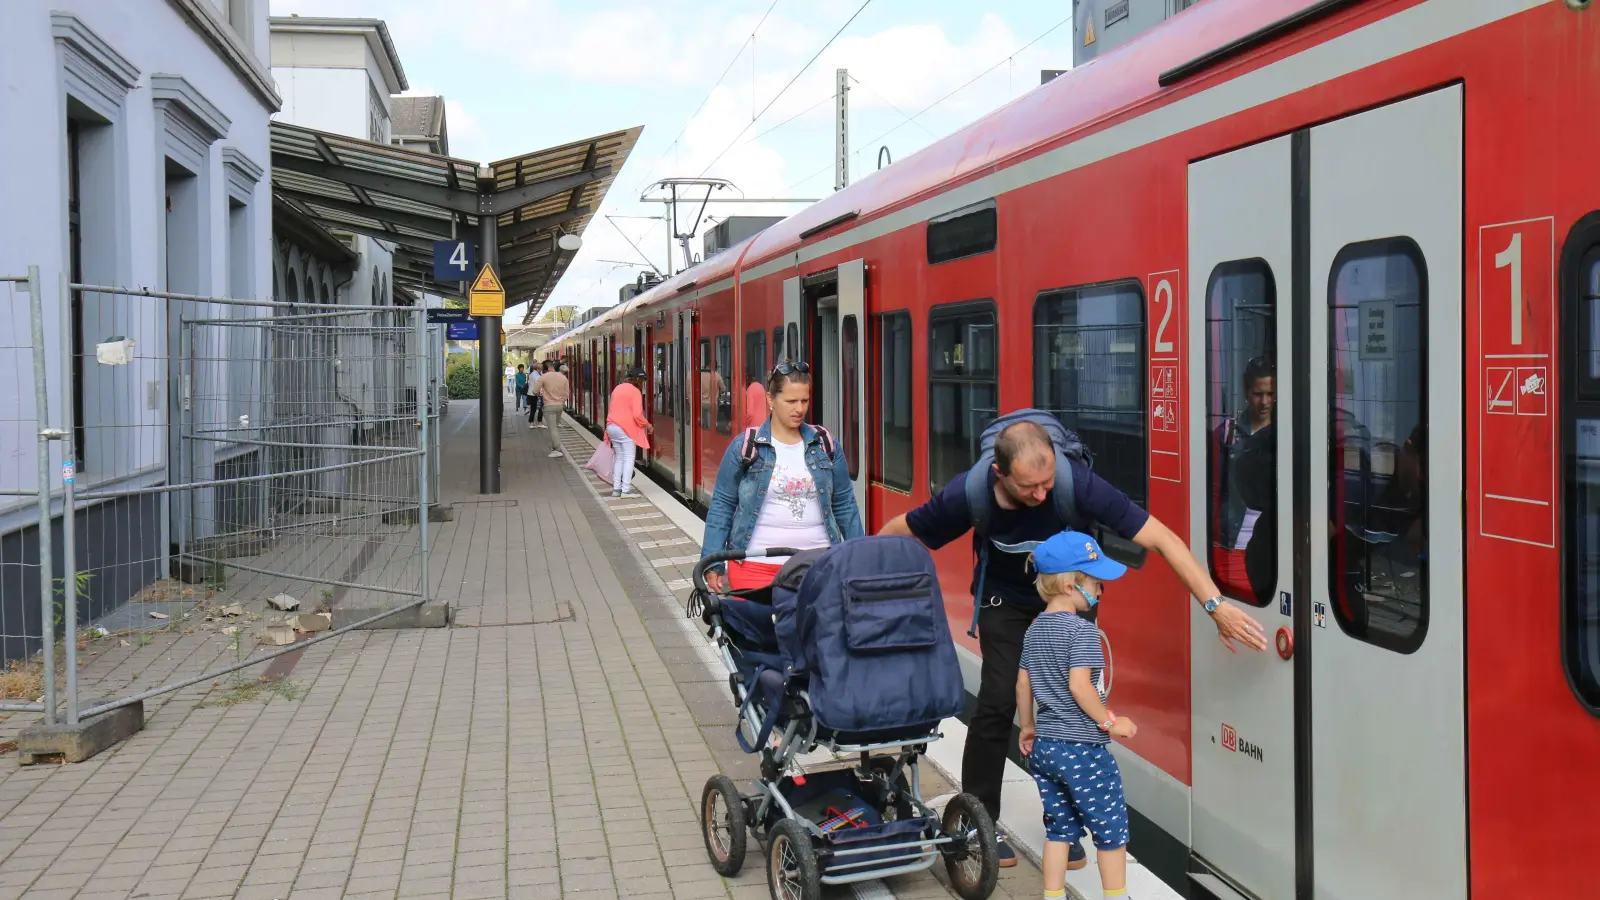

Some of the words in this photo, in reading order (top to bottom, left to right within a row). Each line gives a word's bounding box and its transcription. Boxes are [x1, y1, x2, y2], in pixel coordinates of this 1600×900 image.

[449, 242, 468, 271] 4
[1154, 279, 1173, 352] 2
[1495, 232, 1522, 345] 1
[1223, 726, 1235, 749] DB
[1239, 737, 1263, 762] BAHN
